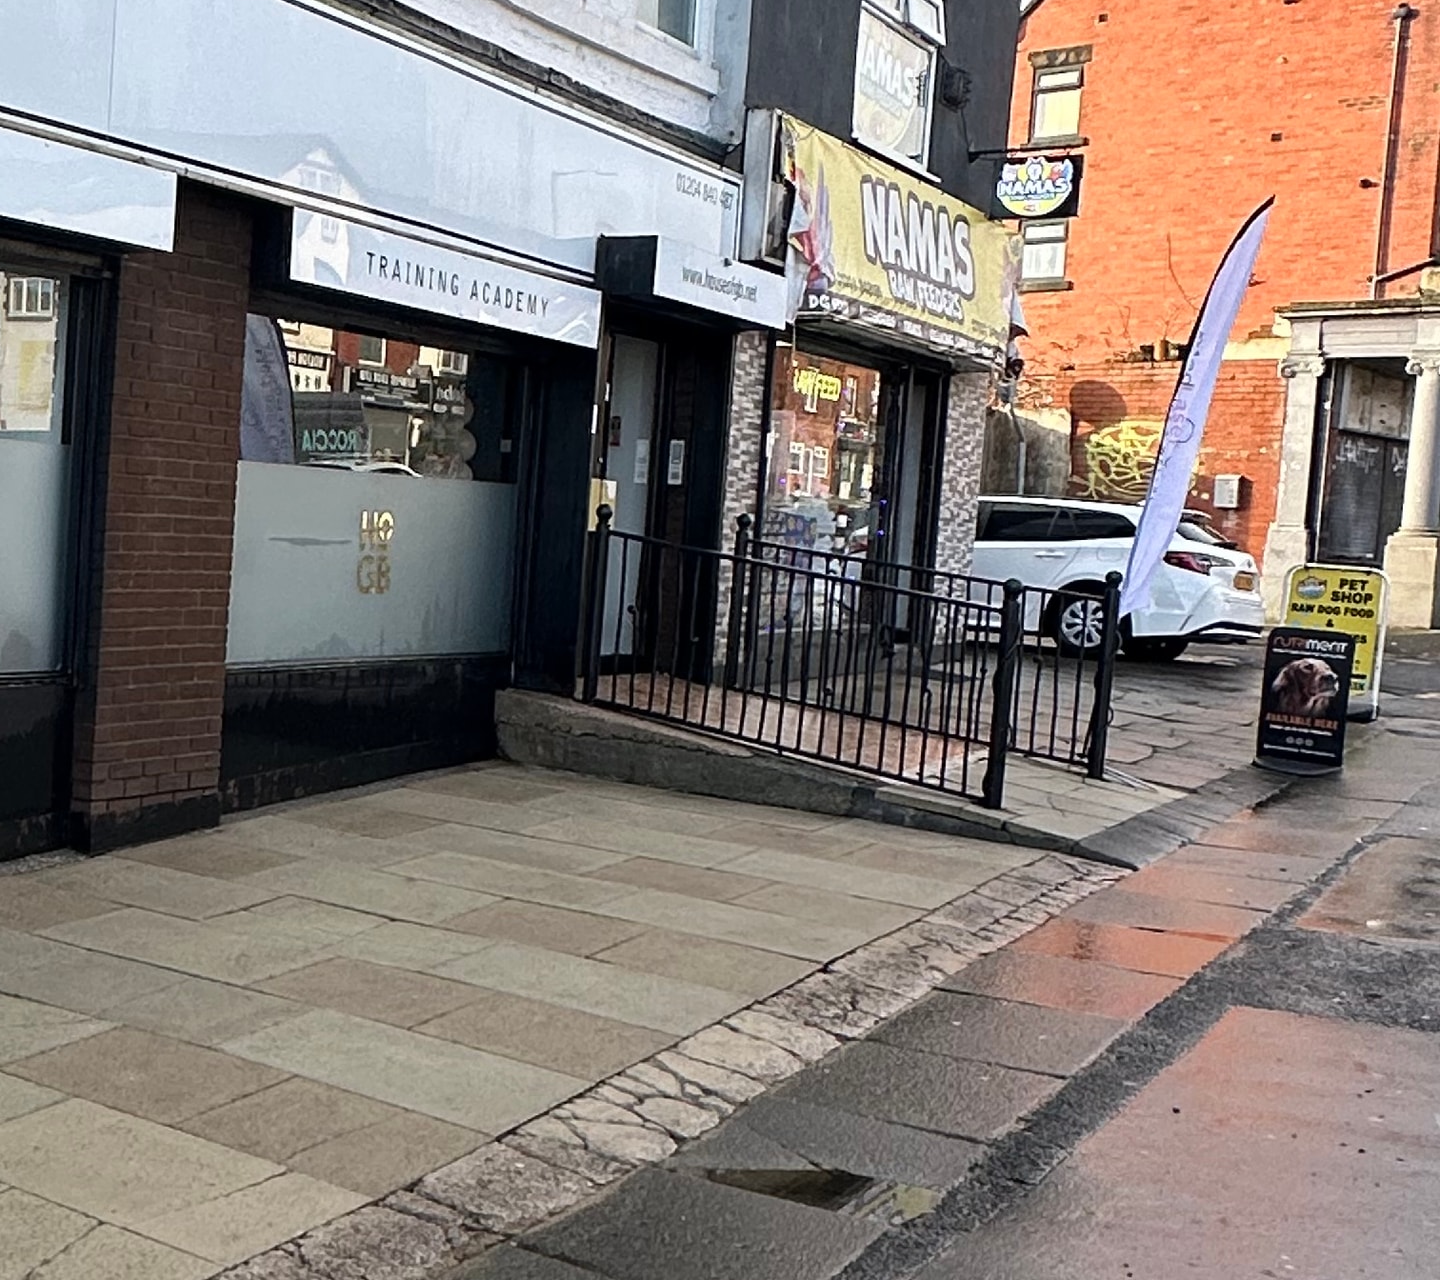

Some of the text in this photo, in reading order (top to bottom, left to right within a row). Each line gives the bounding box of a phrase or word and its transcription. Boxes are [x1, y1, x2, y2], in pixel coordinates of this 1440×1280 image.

[999, 177, 1069, 196] NAMAS
[860, 175, 974, 299] NAMAS
[366, 250, 551, 319] TRAINING ACADEMY
[889, 269, 915, 301] RAW
[915, 280, 963, 321] FEEDERS
[1339, 577, 1369, 591] PET
[1330, 590, 1374, 606] SHOP
[1290, 602, 1375, 619] RAW DOG FOOD
